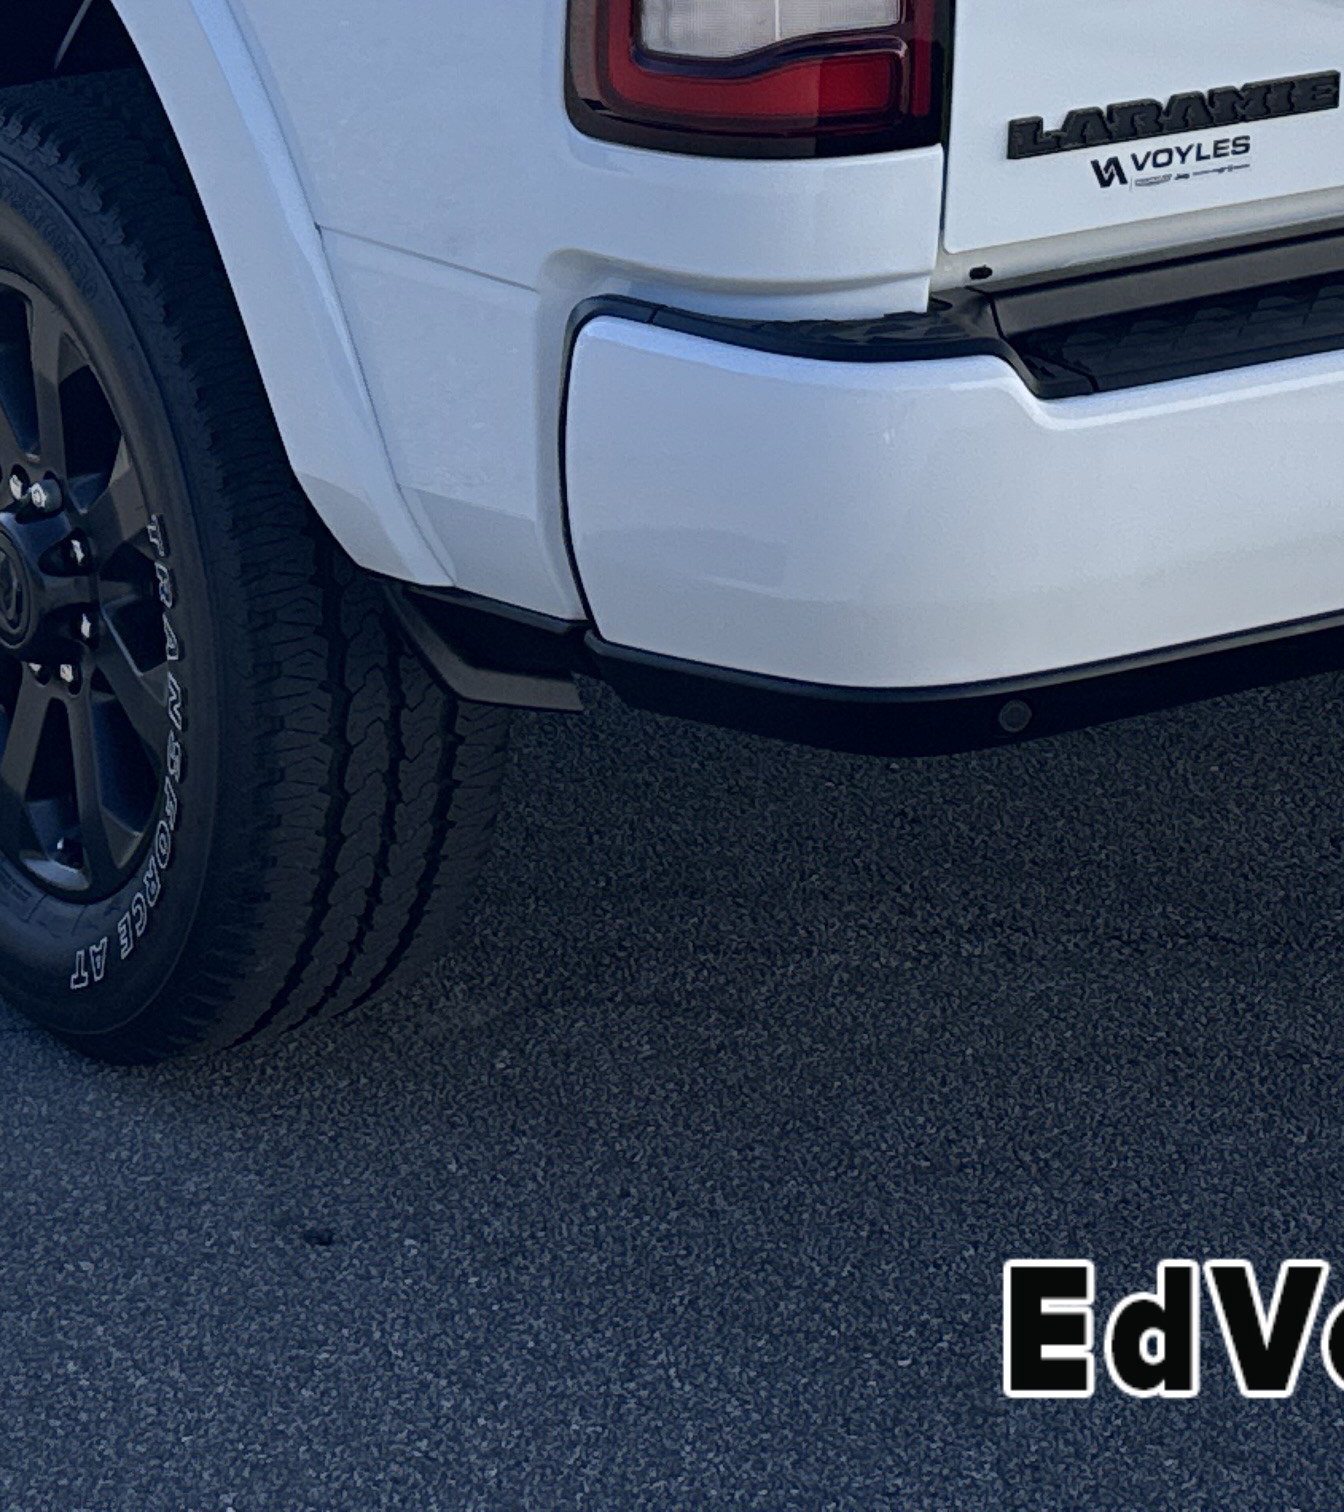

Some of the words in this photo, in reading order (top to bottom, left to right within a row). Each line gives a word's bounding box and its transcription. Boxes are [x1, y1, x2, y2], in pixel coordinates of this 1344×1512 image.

[1007, 69, 1342, 160] LARAMIE
[1130, 135, 1251, 171] VOYLES
[118, 513, 184, 960] TRANSFORCE
[69, 936, 109, 990] AT
